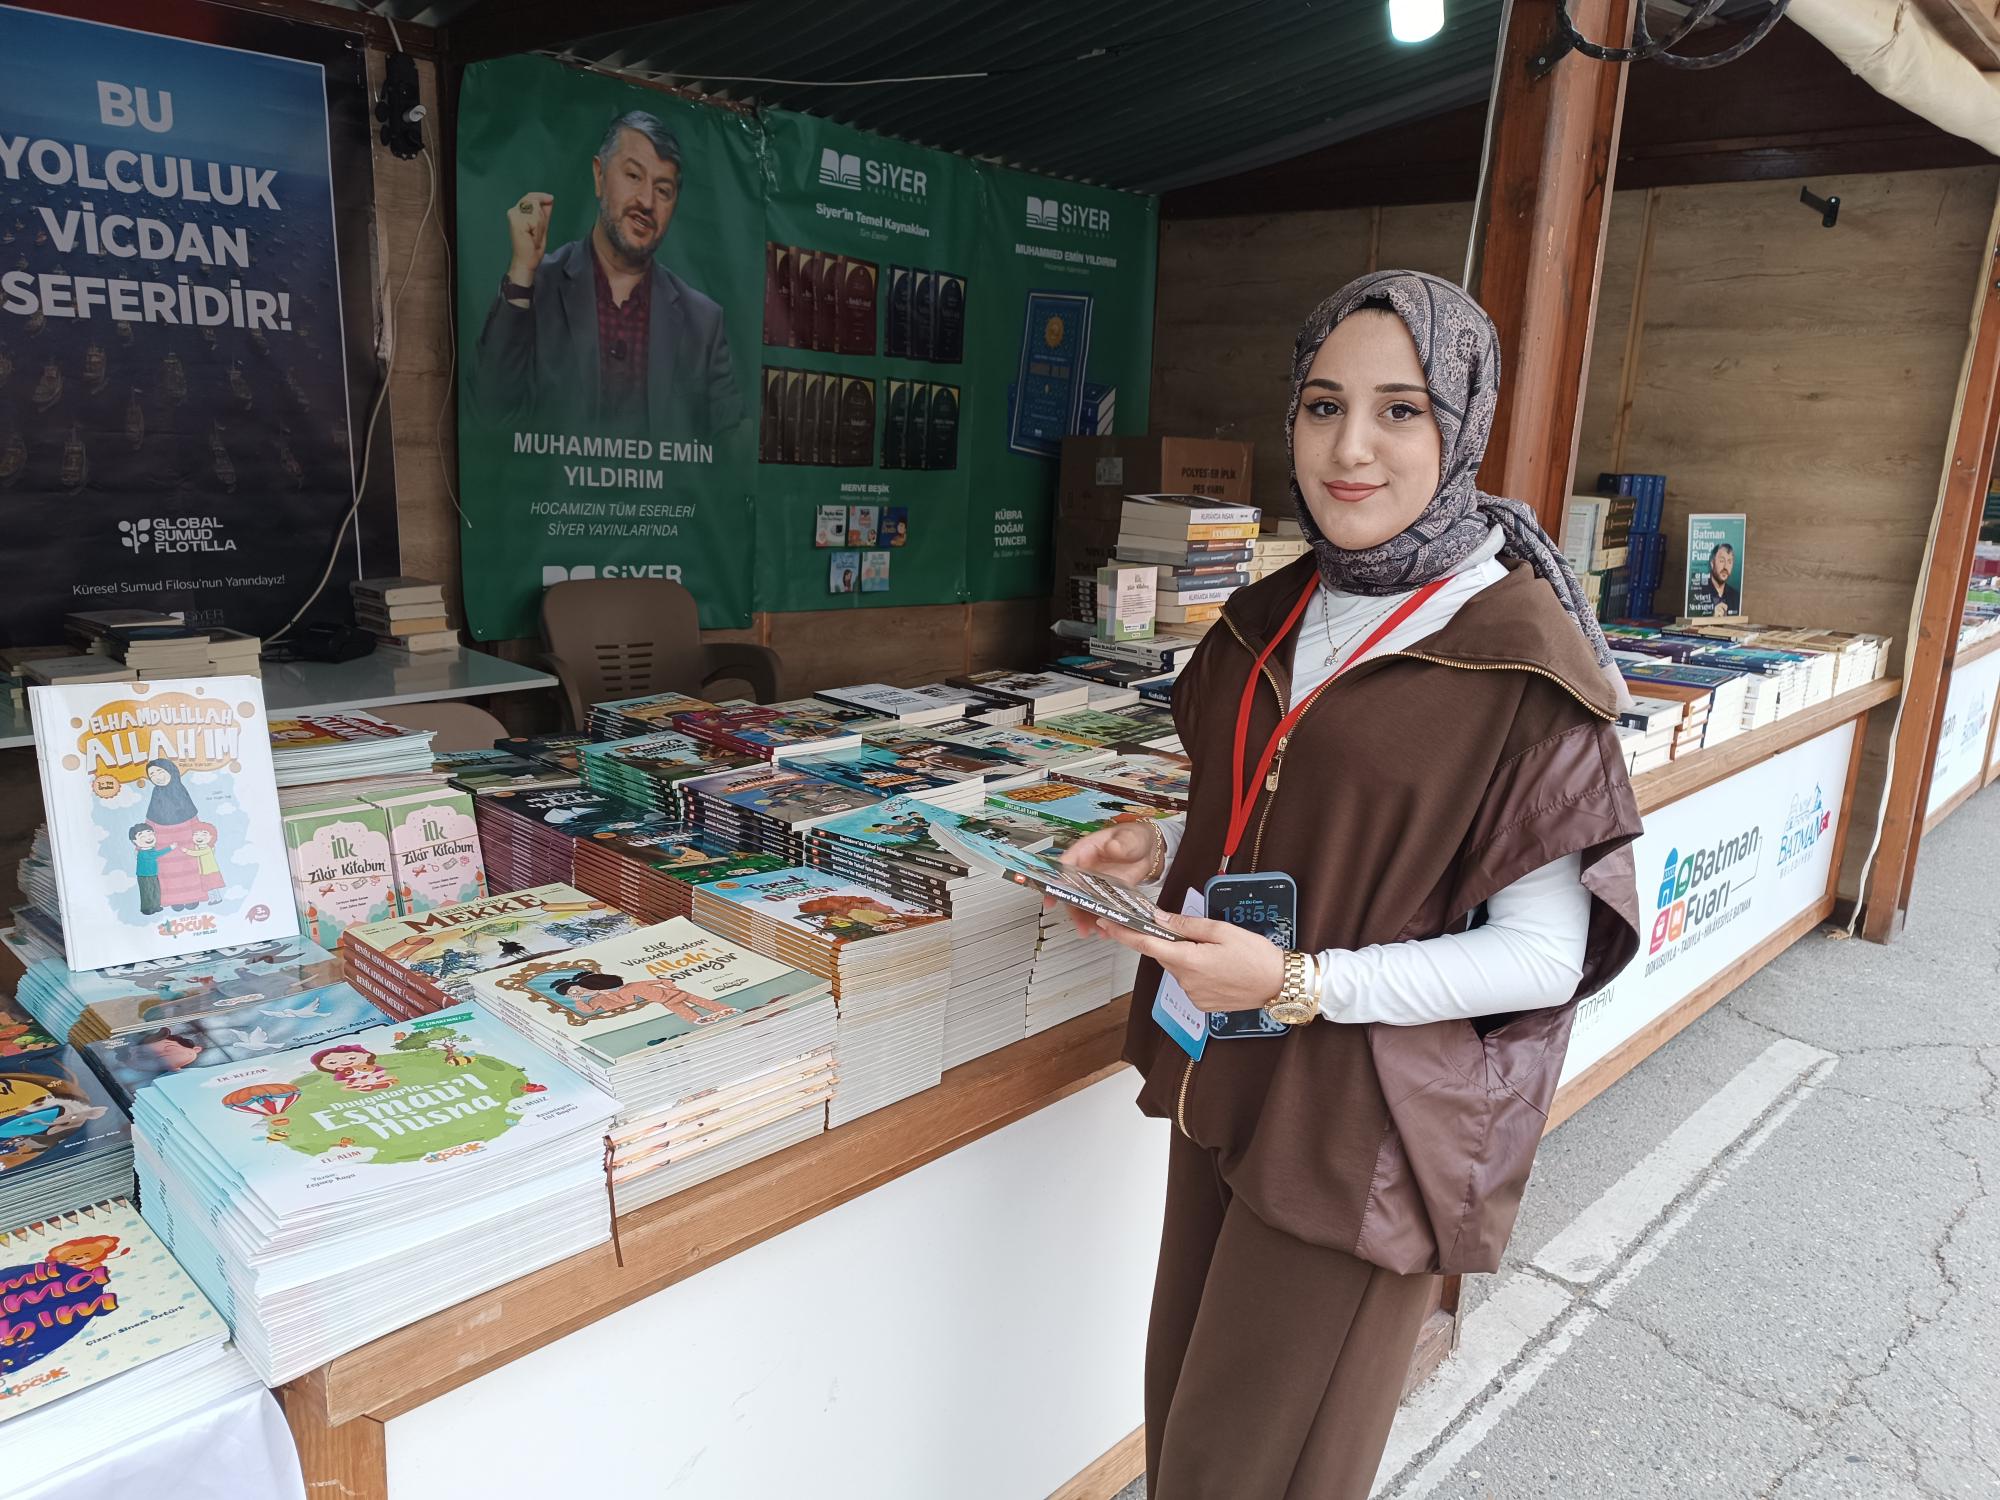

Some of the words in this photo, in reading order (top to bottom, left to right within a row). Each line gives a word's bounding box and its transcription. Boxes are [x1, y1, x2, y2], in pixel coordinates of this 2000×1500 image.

[96, 80, 174, 133] BU
[0, 136, 282, 211] YOLCULUK
[856, 210, 884, 228] Temel
[38, 200, 250, 268] VİCDAN
[1015, 243, 1063, 260] MUHAMMED
[1085, 254, 1117, 268] YILDIRIM
[1, 271, 293, 331] SEFERİDİR!
[513, 432, 653, 460] MUHAMMED
[659, 438, 713, 464] EMİN
[564, 465, 664, 489] YILDIRIM
[840, 483, 867, 493] MERVE
[530, 502, 605, 516] HOCAMIZIN
[609, 501, 637, 517] TÜM
[639, 503, 696, 518] ESERLERİ
[995, 508, 1023, 520] KÜBRA
[153, 516, 224, 530] GLOBAL
[154, 529, 213, 541] SUMUD
[548, 520, 585, 536] SİYER
[588, 523, 679, 536] YAYINLARI'NDA
[994, 521, 1024, 534] DOĞAN
[1693, 530, 1725, 539] Batman
[154, 539, 237, 553] FLOTILLA
[994, 536, 1027, 547] TUNCER
[1692, 540, 1715, 551] Kitap
[72, 583, 118, 596] Küresel
[121, 580, 163, 593] Sumud
[165, 577, 223, 591] Filosu'nun
[225, 574, 286, 588] Yanındayız!
[89, 702, 233, 735] ELHAMDÜLİLLAH
[86, 726, 239, 775] ALLAH'IM
[402, 845, 430, 866] Zikir
[432, 840, 475, 857] Kitabım
[1777, 814, 1822, 867] BATMAN
[1690, 826, 1760, 888] Batman
[308, 866, 337, 884] Zikir
[341, 859, 386, 876] Kitabım
[401, 893, 548, 934] MEKKE
[1222, 905, 1279, 923] 13:55
[1683, 880, 1731, 933] Fuarı
[620, 938, 708, 967] Vücudundan
[642, 941, 673, 953] Elif
[354, 943, 371, 959] BENİM
[384, 961, 404, 981] MEKKE
[656, 952, 738, 983] Soruyor
[310, 1073, 489, 1132] Esmaü'l
[329, 1084, 424, 1111] Duygularla
[365, 1094, 502, 1140] Hüsna
[85, 1331, 118, 1347] Çizer:
[117, 1319, 149, 1335] Sinem
[150, 1304, 186, 1322] Öztürk
